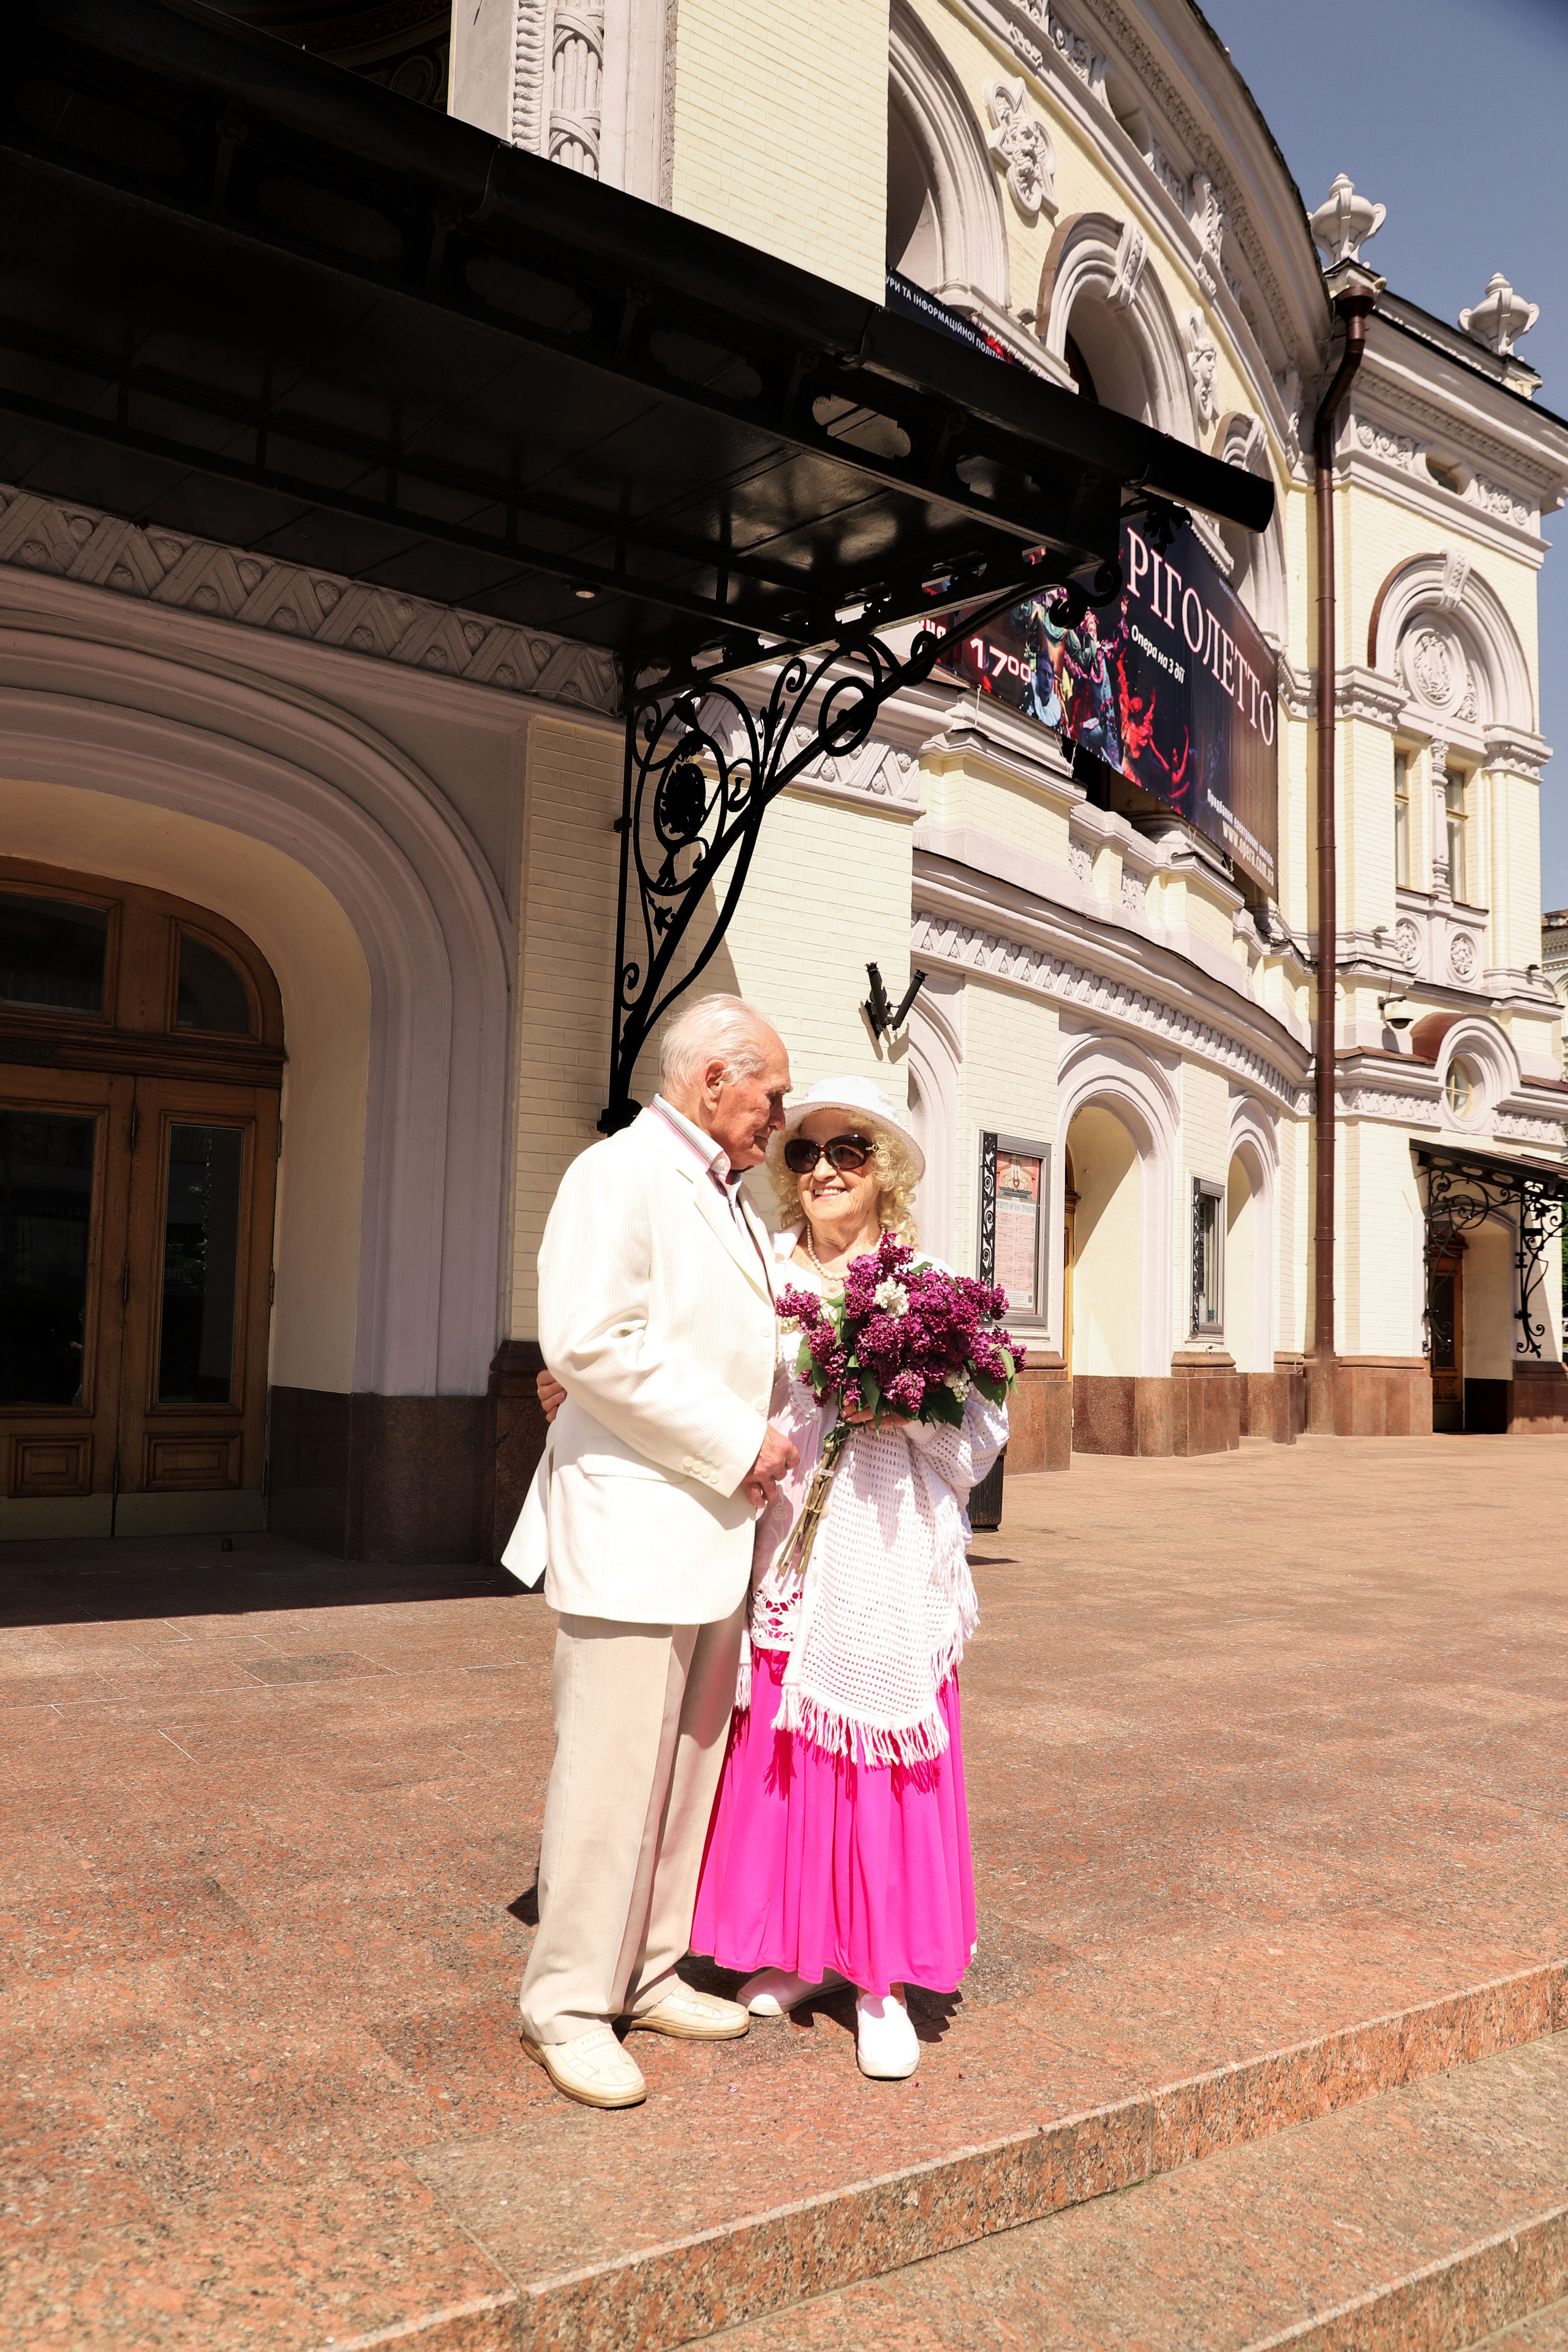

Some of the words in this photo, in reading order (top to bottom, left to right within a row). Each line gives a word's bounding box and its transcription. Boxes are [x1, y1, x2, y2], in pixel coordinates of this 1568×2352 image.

[902, 285, 911, 301] ТА
[913, 293, 976, 344] ІНФОРМАЦІЙНОЇ
[1126, 525, 1275, 747] РІГОЛЕТТО
[1131, 624, 1158, 660] Опера
[1158, 651, 1168, 669] на
[1168, 658, 1174, 674] 3
[1174, 662, 1185, 684] дії
[1223, 820, 1274, 887] www.opera.com.ua
[996, 1200, 1014, 1211] ЕПЕРТУАР
